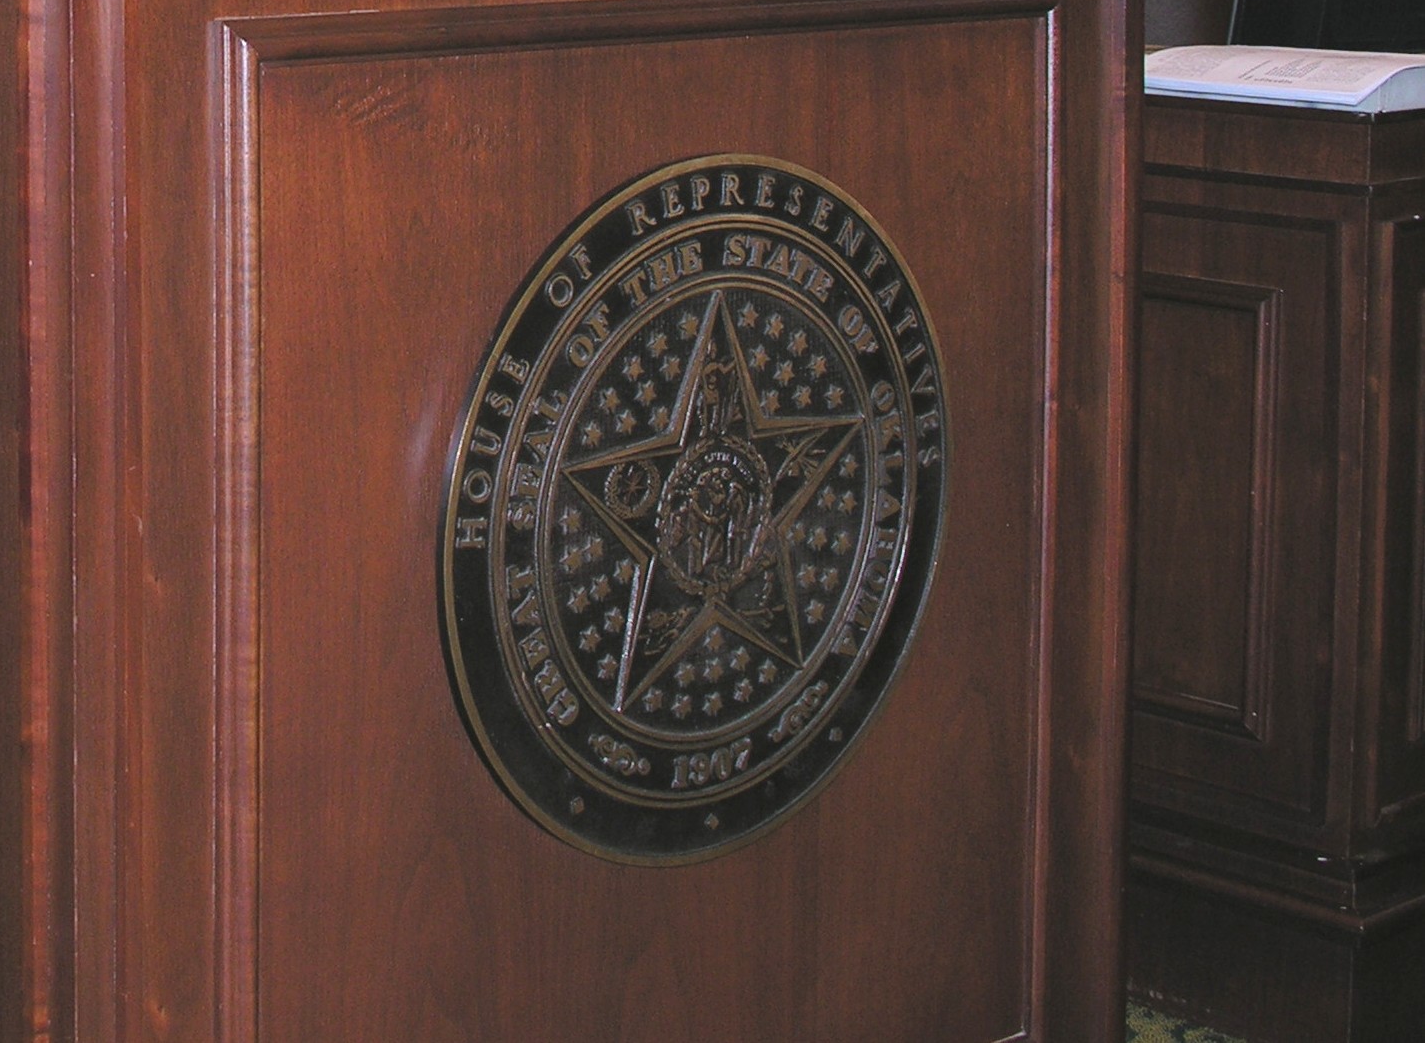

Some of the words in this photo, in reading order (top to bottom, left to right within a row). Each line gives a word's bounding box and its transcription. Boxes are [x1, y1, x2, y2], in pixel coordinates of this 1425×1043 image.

[619, 241, 703, 309] THE
[723, 234, 835, 303] STATE
[457, 352, 531, 549] HOUSE
[545, 243, 593, 309] OF
[625, 172, 941, 468] REPRESENTATIVES
[567, 300, 611, 368] OF
[838, 305, 879, 354] OF
[507, 389, 568, 530] SEAL
[832, 380, 903, 655] OKLAHOMA
[506, 564, 579, 726] GREAT
[671, 737, 754, 789] 1907
